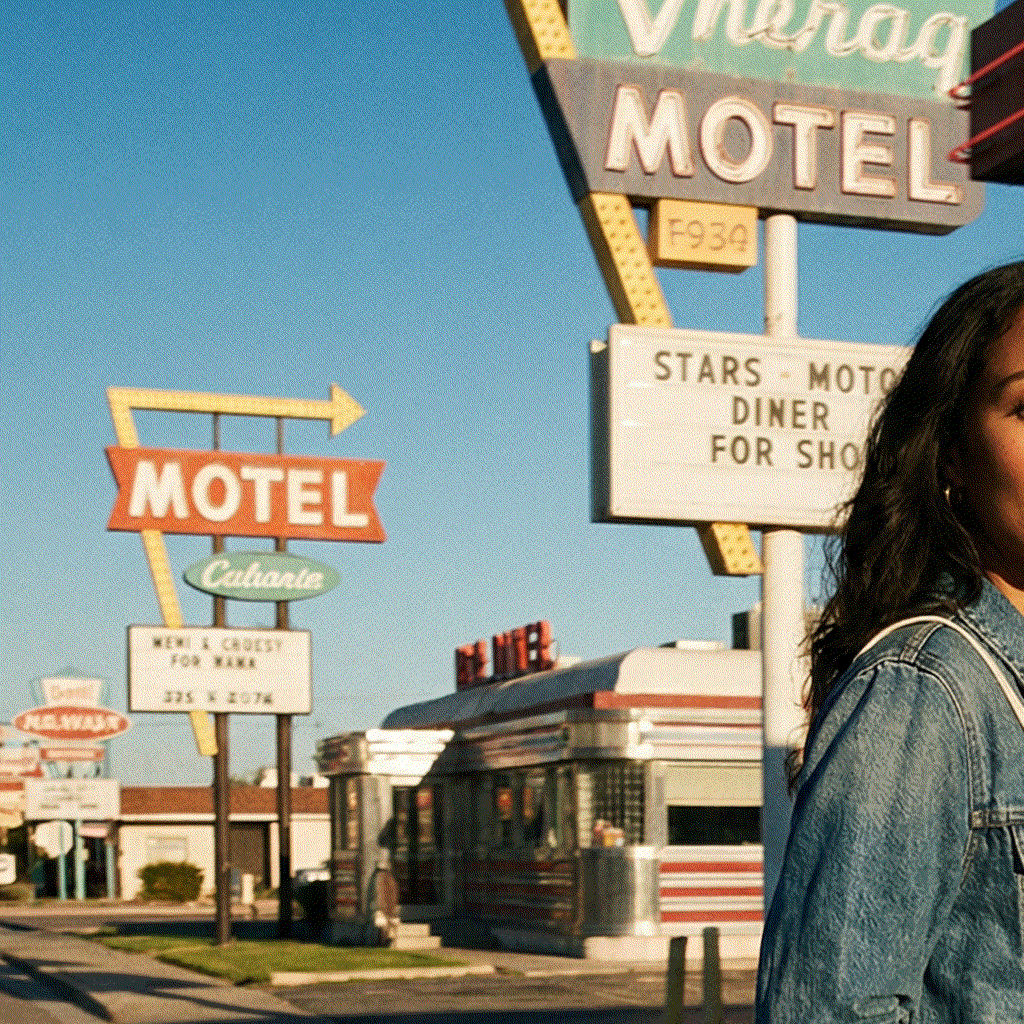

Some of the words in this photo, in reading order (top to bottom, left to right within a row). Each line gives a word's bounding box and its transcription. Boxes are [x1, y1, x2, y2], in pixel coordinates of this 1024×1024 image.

[604, 85, 964, 205] MOTEL
[653, 350, 762, 388] STARS
[731, 395, 831, 430] DINER
[710, 434, 774, 467] FOR
[129, 461, 369, 528] MOTEL
